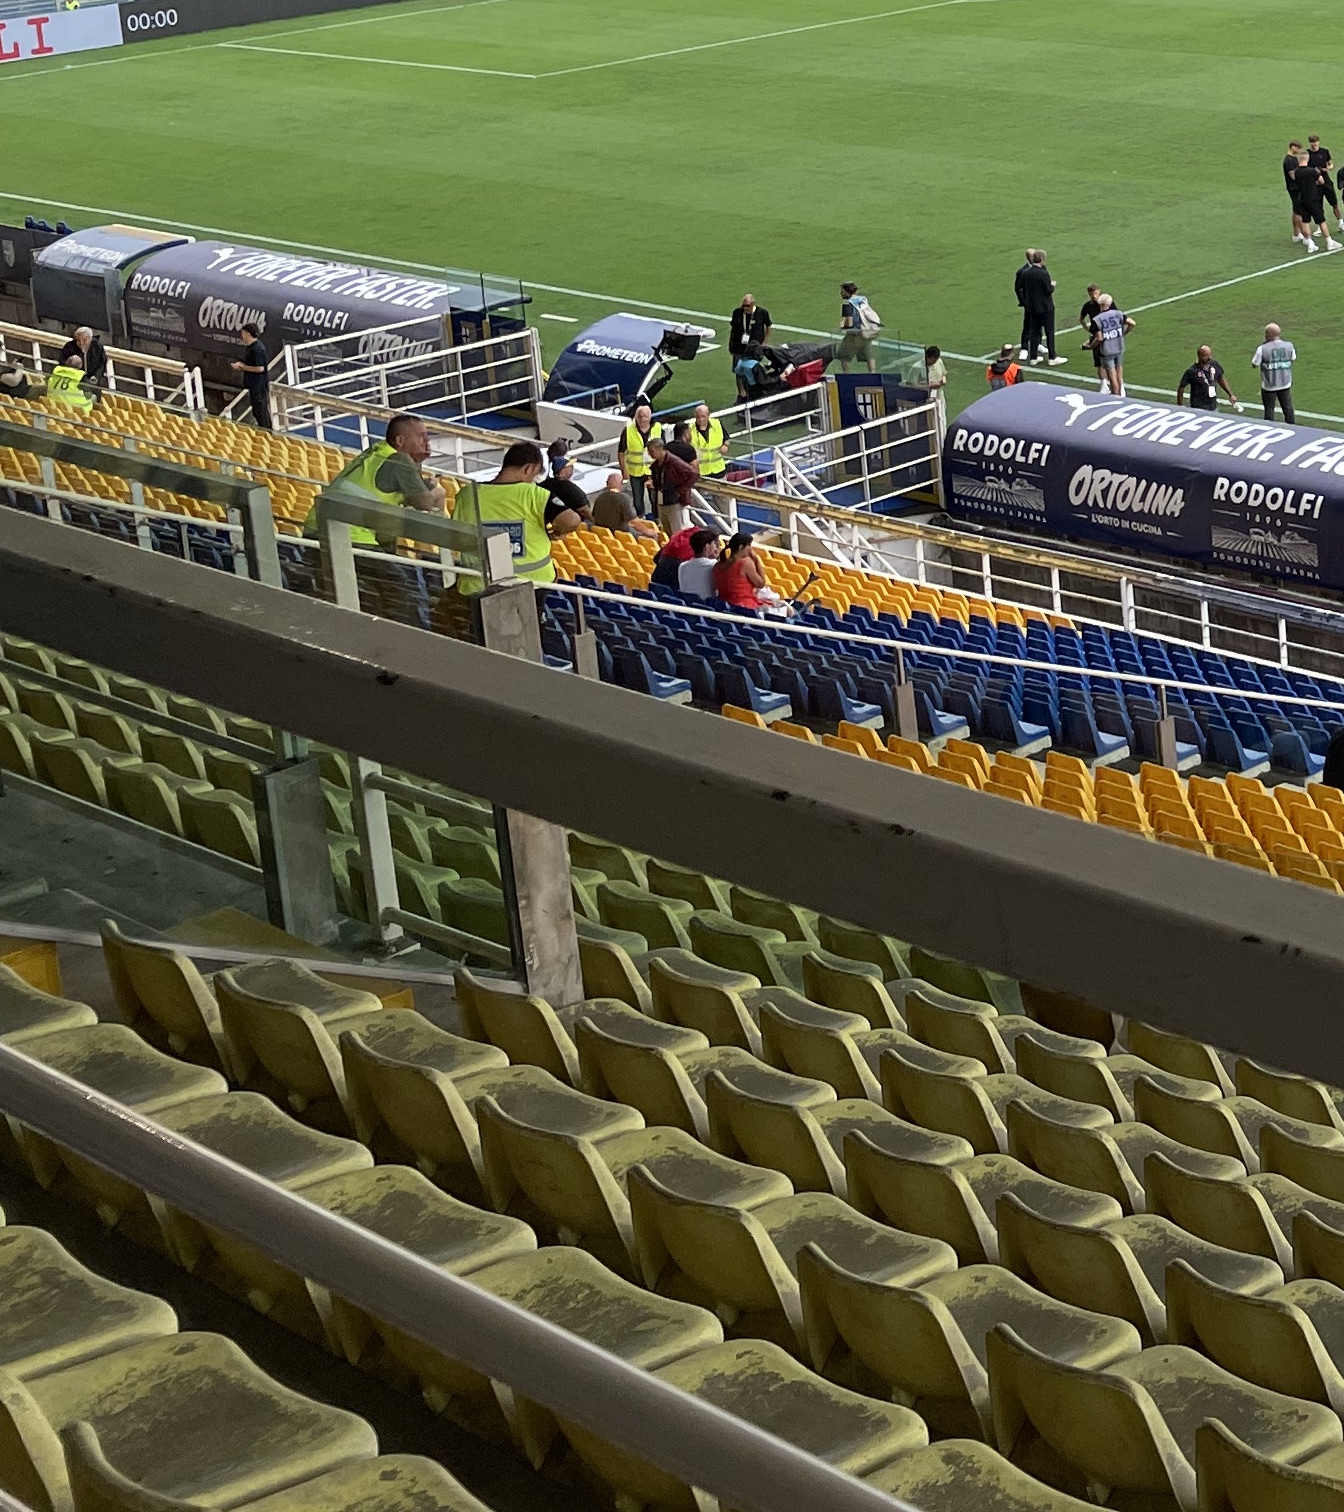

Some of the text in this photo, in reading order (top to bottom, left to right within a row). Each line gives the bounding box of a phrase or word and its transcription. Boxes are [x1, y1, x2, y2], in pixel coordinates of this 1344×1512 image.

[127, 8, 178, 32] 00:00
[53, 239, 129, 263] PROMETEON
[131, 273, 192, 299] RODOLFI
[220, 252, 456, 310] FOREVER. FASTER.
[199, 296, 267, 333] ORTOLINA
[283, 302, 350, 331] RODOLFI
[577, 339, 654, 364] PROMETEON
[1088, 403, 1296, 462] FOREVER.
[953, 428, 1051, 467] RODOLFI
[981, 461, 1013, 475] 1896
[1069, 464, 1185, 517] ORTOLINA
[1213, 476, 1324, 520] RODOLFI
[1091, 512, 1162, 536] L'ORTO IN CUCINA
[1246, 512, 1282, 527] 1896
[1212, 551, 1271, 570] POMODORO
[1285, 566, 1321, 580] PARMA
